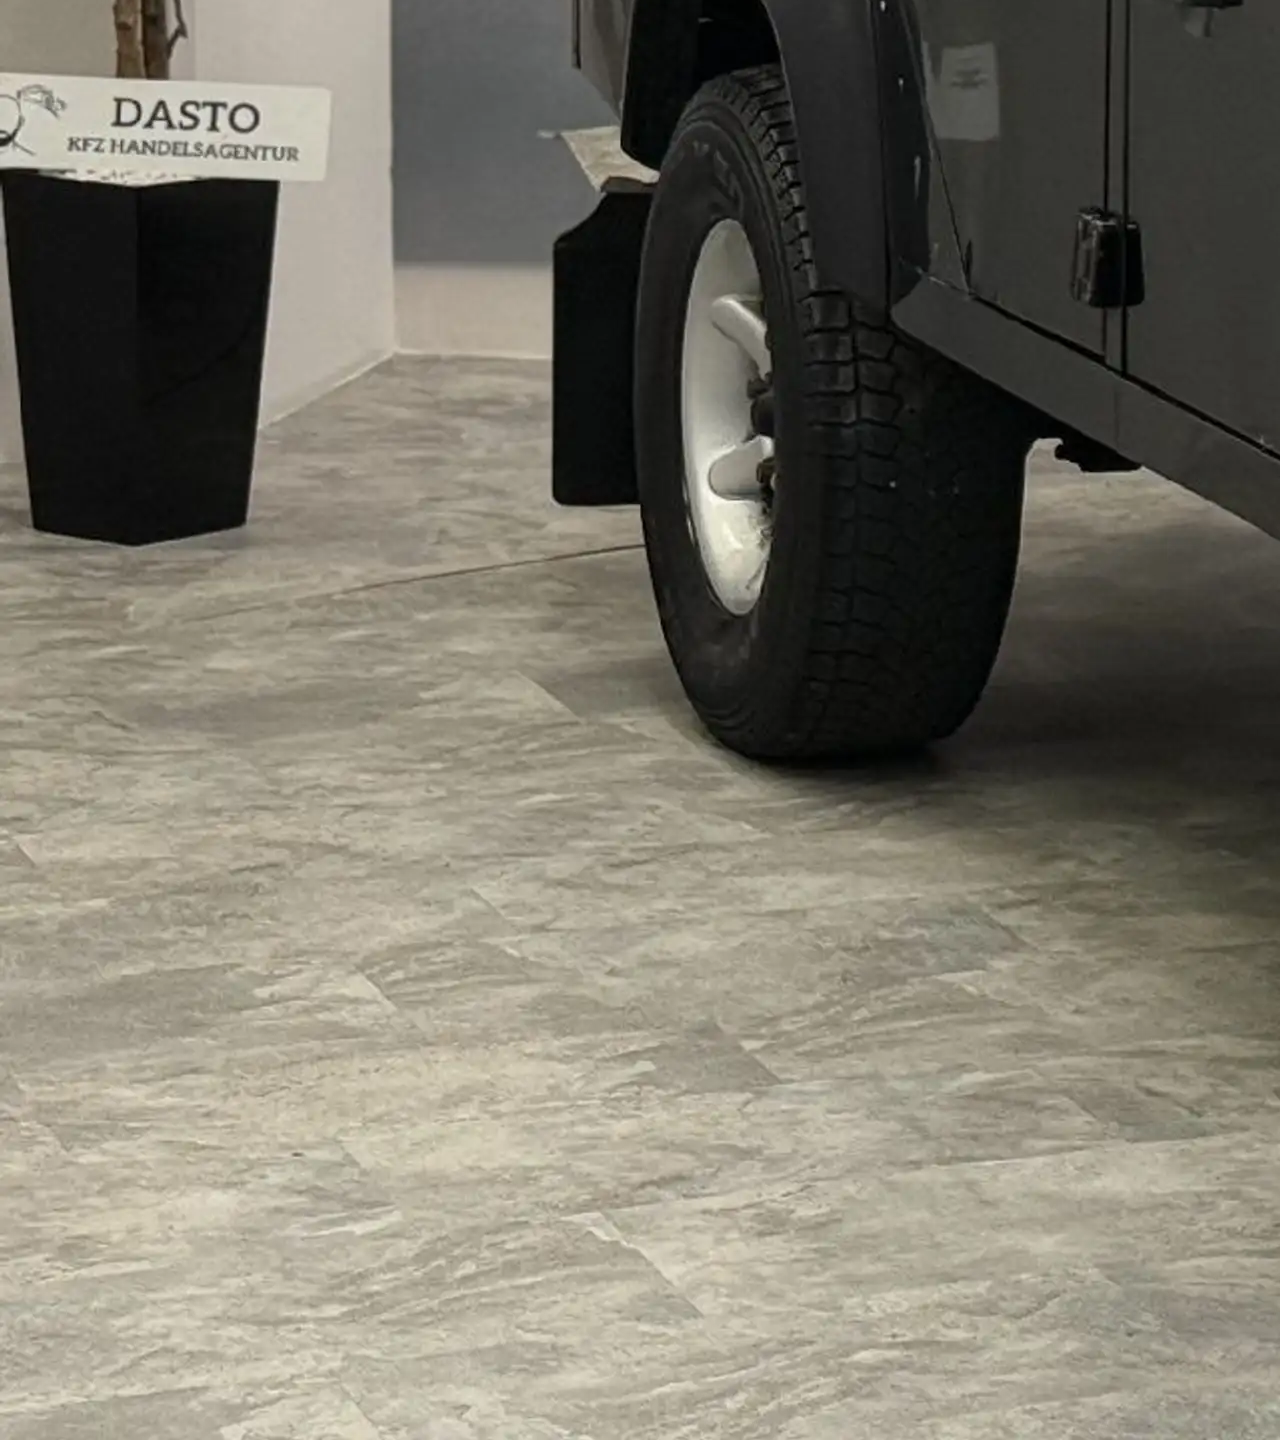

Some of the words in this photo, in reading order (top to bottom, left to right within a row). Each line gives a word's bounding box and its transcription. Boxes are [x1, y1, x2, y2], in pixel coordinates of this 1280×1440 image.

[110, 96, 260, 134] DASTO
[66, 136, 106, 155] KFZ
[109, 137, 300, 162] HANDELSAGENTUR
